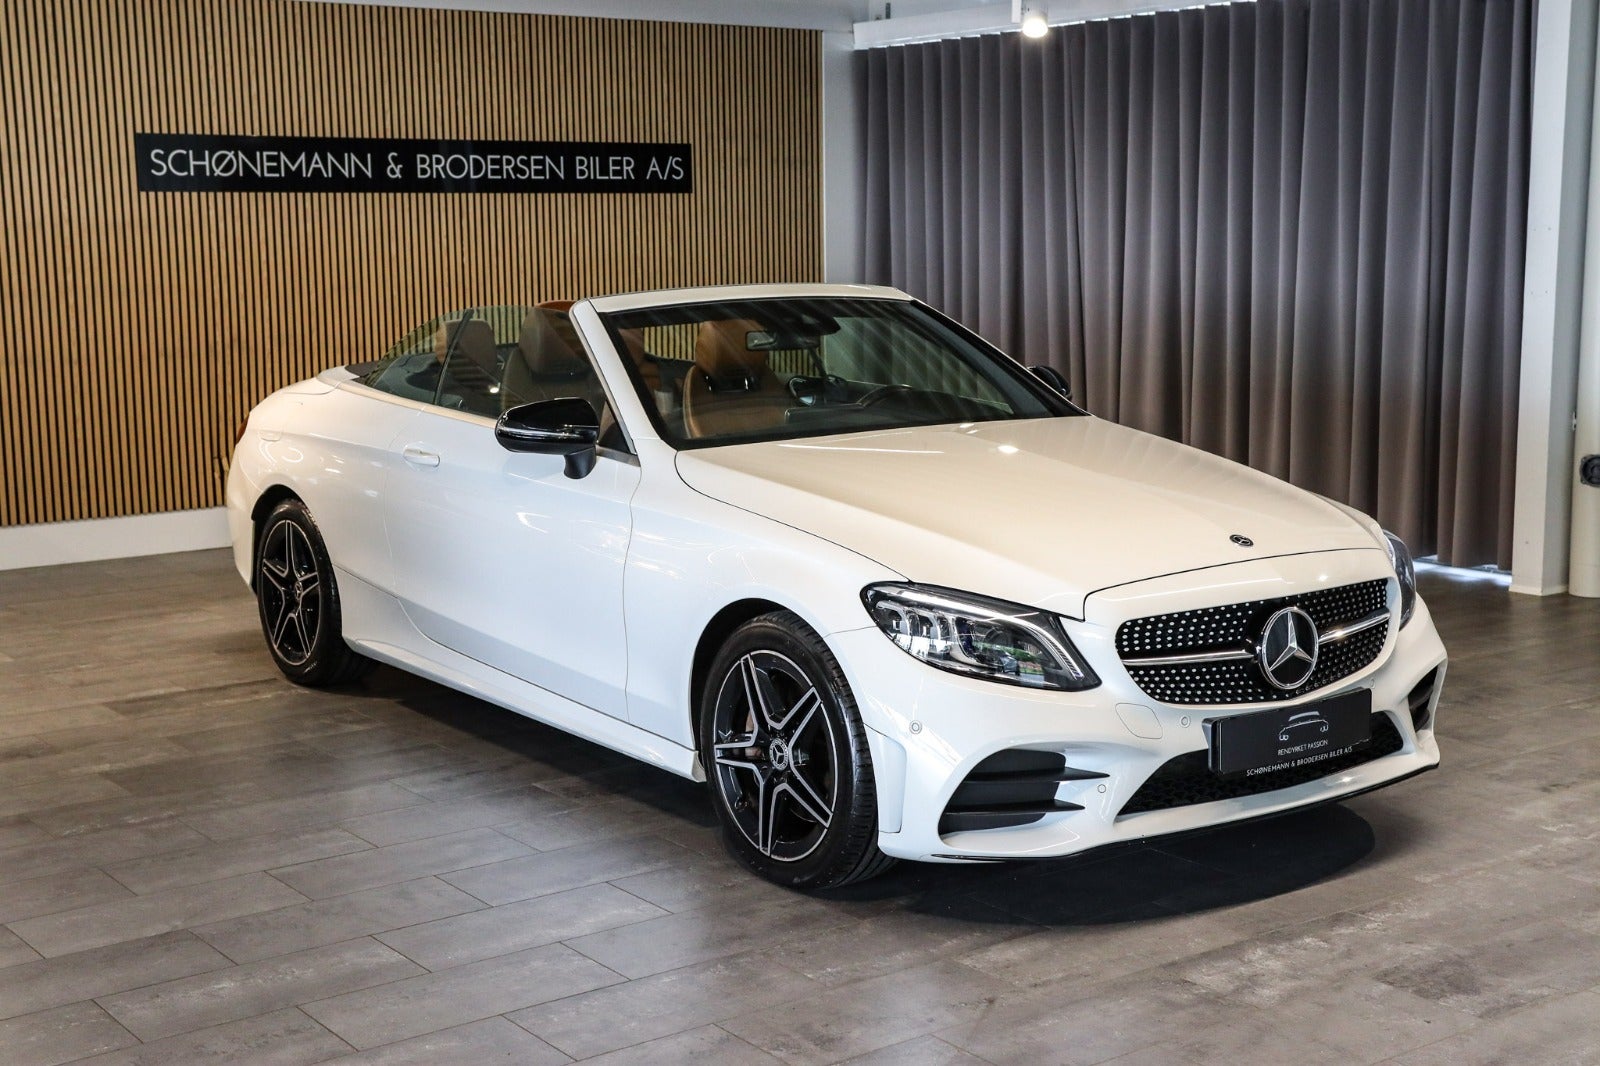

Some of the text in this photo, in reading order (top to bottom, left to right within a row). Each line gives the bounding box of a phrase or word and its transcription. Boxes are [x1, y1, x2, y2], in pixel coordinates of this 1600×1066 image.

[150, 149, 684, 180] SCHØNEMANN & BRODERSEN BILER A/S
[1277, 740, 1328, 756] RENDYRKET PASSION
[1246, 762, 1290, 776] SCHØNEMANN
[1297, 753, 1328, 766] BRODERSEN
[1329, 749, 1343, 758] BILER
